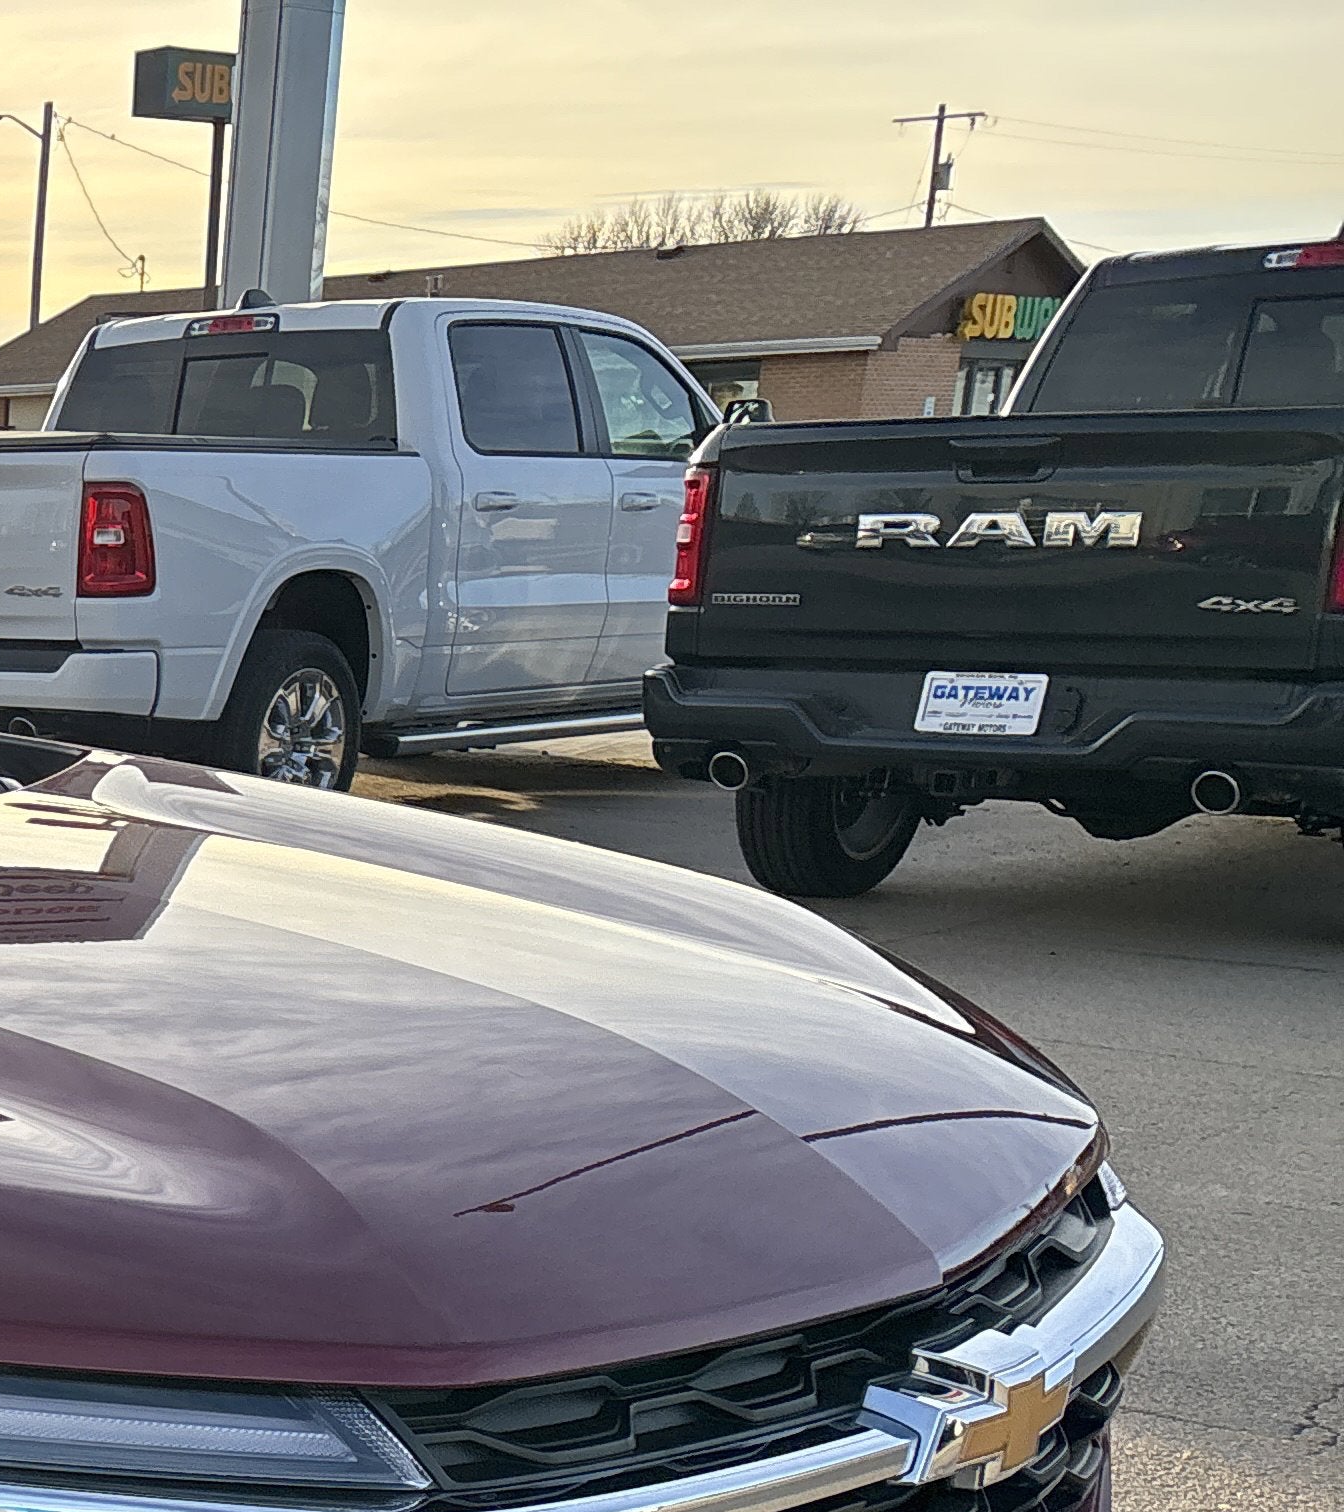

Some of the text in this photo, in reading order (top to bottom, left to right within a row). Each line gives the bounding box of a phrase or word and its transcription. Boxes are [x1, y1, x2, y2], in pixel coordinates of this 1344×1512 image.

[171, 62, 231, 104] SUB
[964, 293, 1062, 341] SUBWA
[855, 511, 1144, 548] RAM
[1197, 596, 1301, 615] 4x4
[932, 684, 1037, 702] GATEWAY
